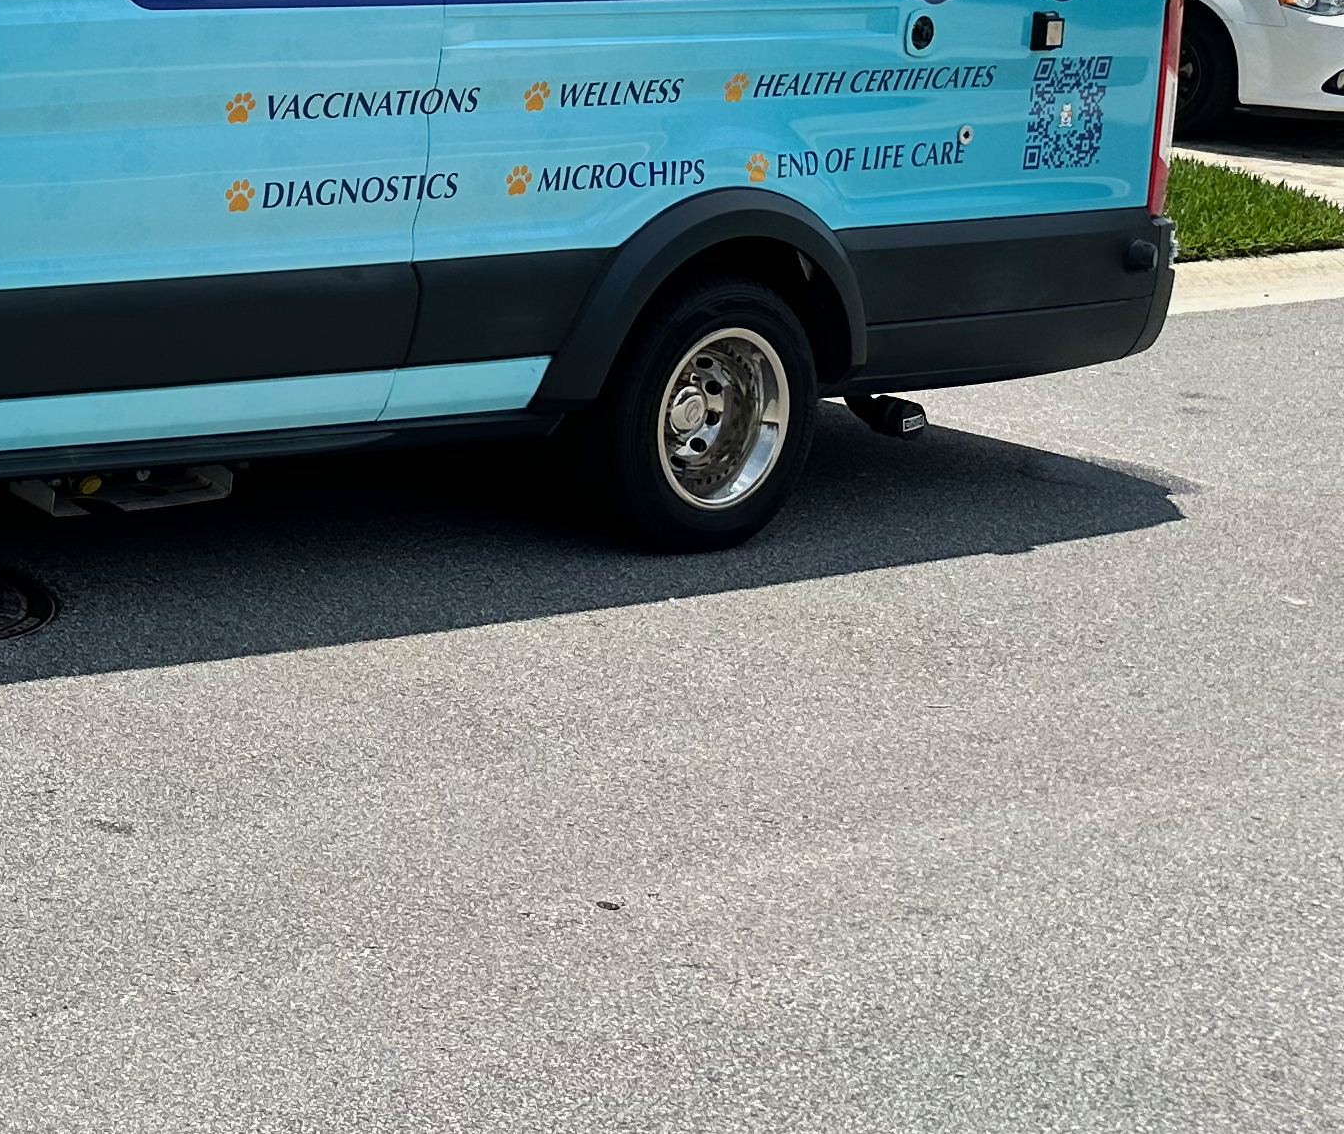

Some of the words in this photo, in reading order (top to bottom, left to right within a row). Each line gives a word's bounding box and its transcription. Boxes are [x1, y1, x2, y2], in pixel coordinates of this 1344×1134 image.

[559, 78, 685, 108] WELLNESS
[752, 71, 847, 99] HEALTH
[849, 65, 998, 95] CERTIFICATES
[266, 87, 481, 121] VACCINATIONS
[536, 158, 705, 193] MICROCHIPS
[776, 150, 819, 179] END
[824, 147, 856, 174] OF
[861, 143, 905, 171] LIFE
[910, 140, 966, 168] CARE
[261, 172, 459, 210] DIAGNOSTICS
